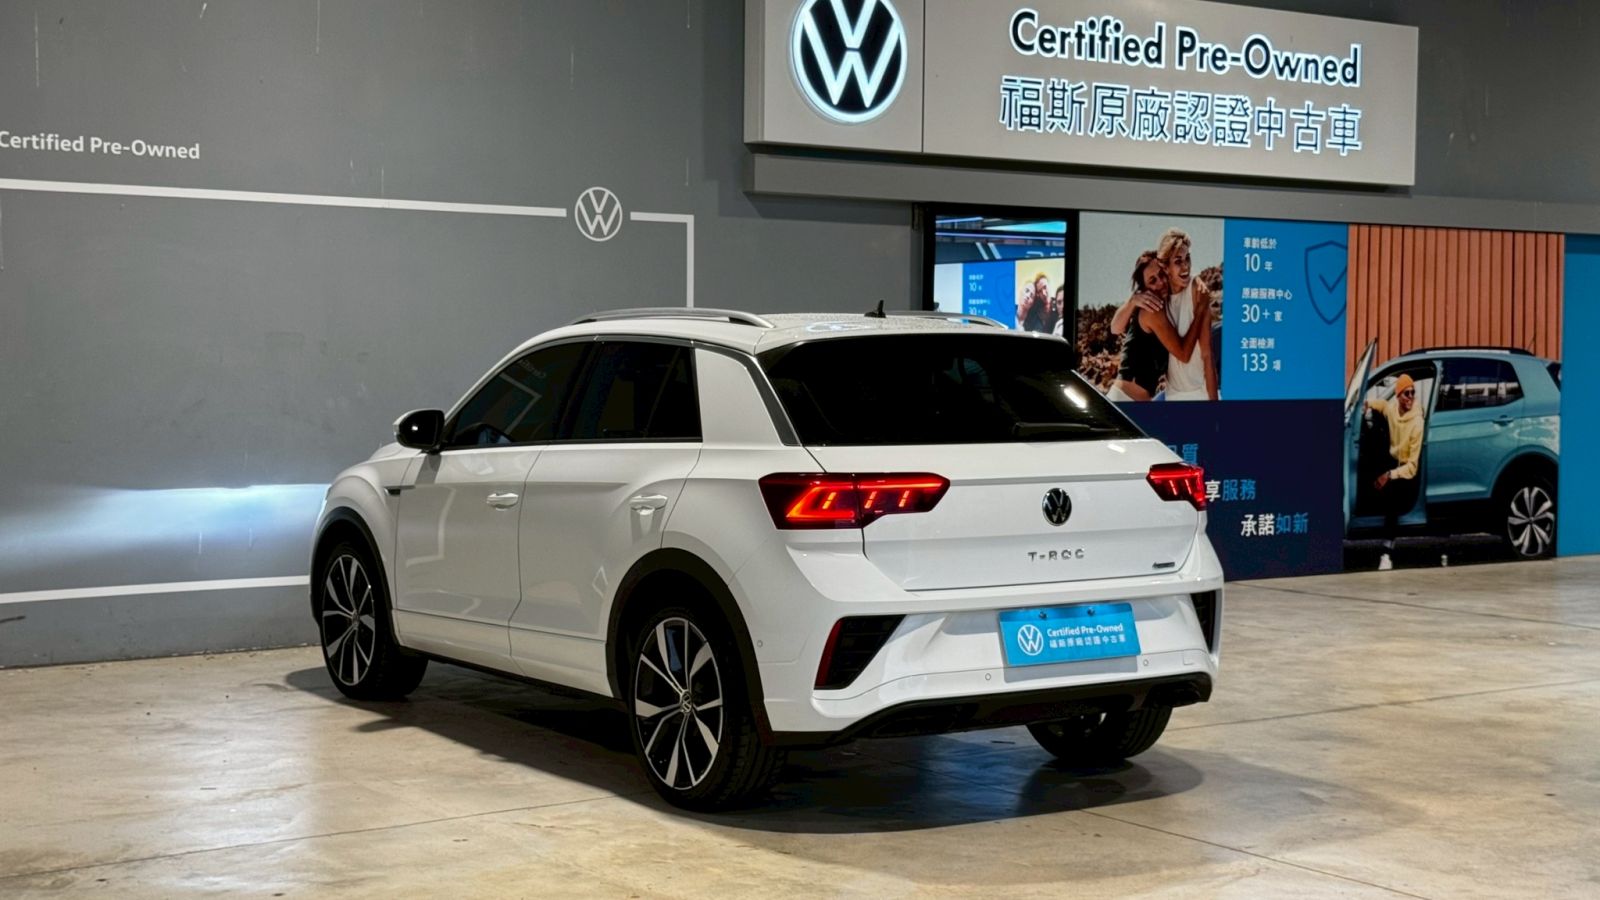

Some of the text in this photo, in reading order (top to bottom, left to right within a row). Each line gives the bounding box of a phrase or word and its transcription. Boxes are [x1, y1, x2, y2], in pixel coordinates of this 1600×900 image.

[1010, 8, 1361, 87] Certified Pre-Owned
[1000, 75, 1362, 156] 福斯原廠認證中古車
[0, 131, 200, 159] Certified Pre-Owned
[1243, 237, 1277, 249] 車齡低於
[1244, 253, 1273, 272] 10 年
[1241, 287, 1292, 300] 原廠服務中心
[1240, 337, 1275, 349] 全面檢測
[1242, 353, 1268, 372] 133
[1240, 512, 1309, 537] 承諾如新
[1028, 549, 1085, 562] T-ROC
[1047, 623, 1123, 638] Certified Pre-Owned
